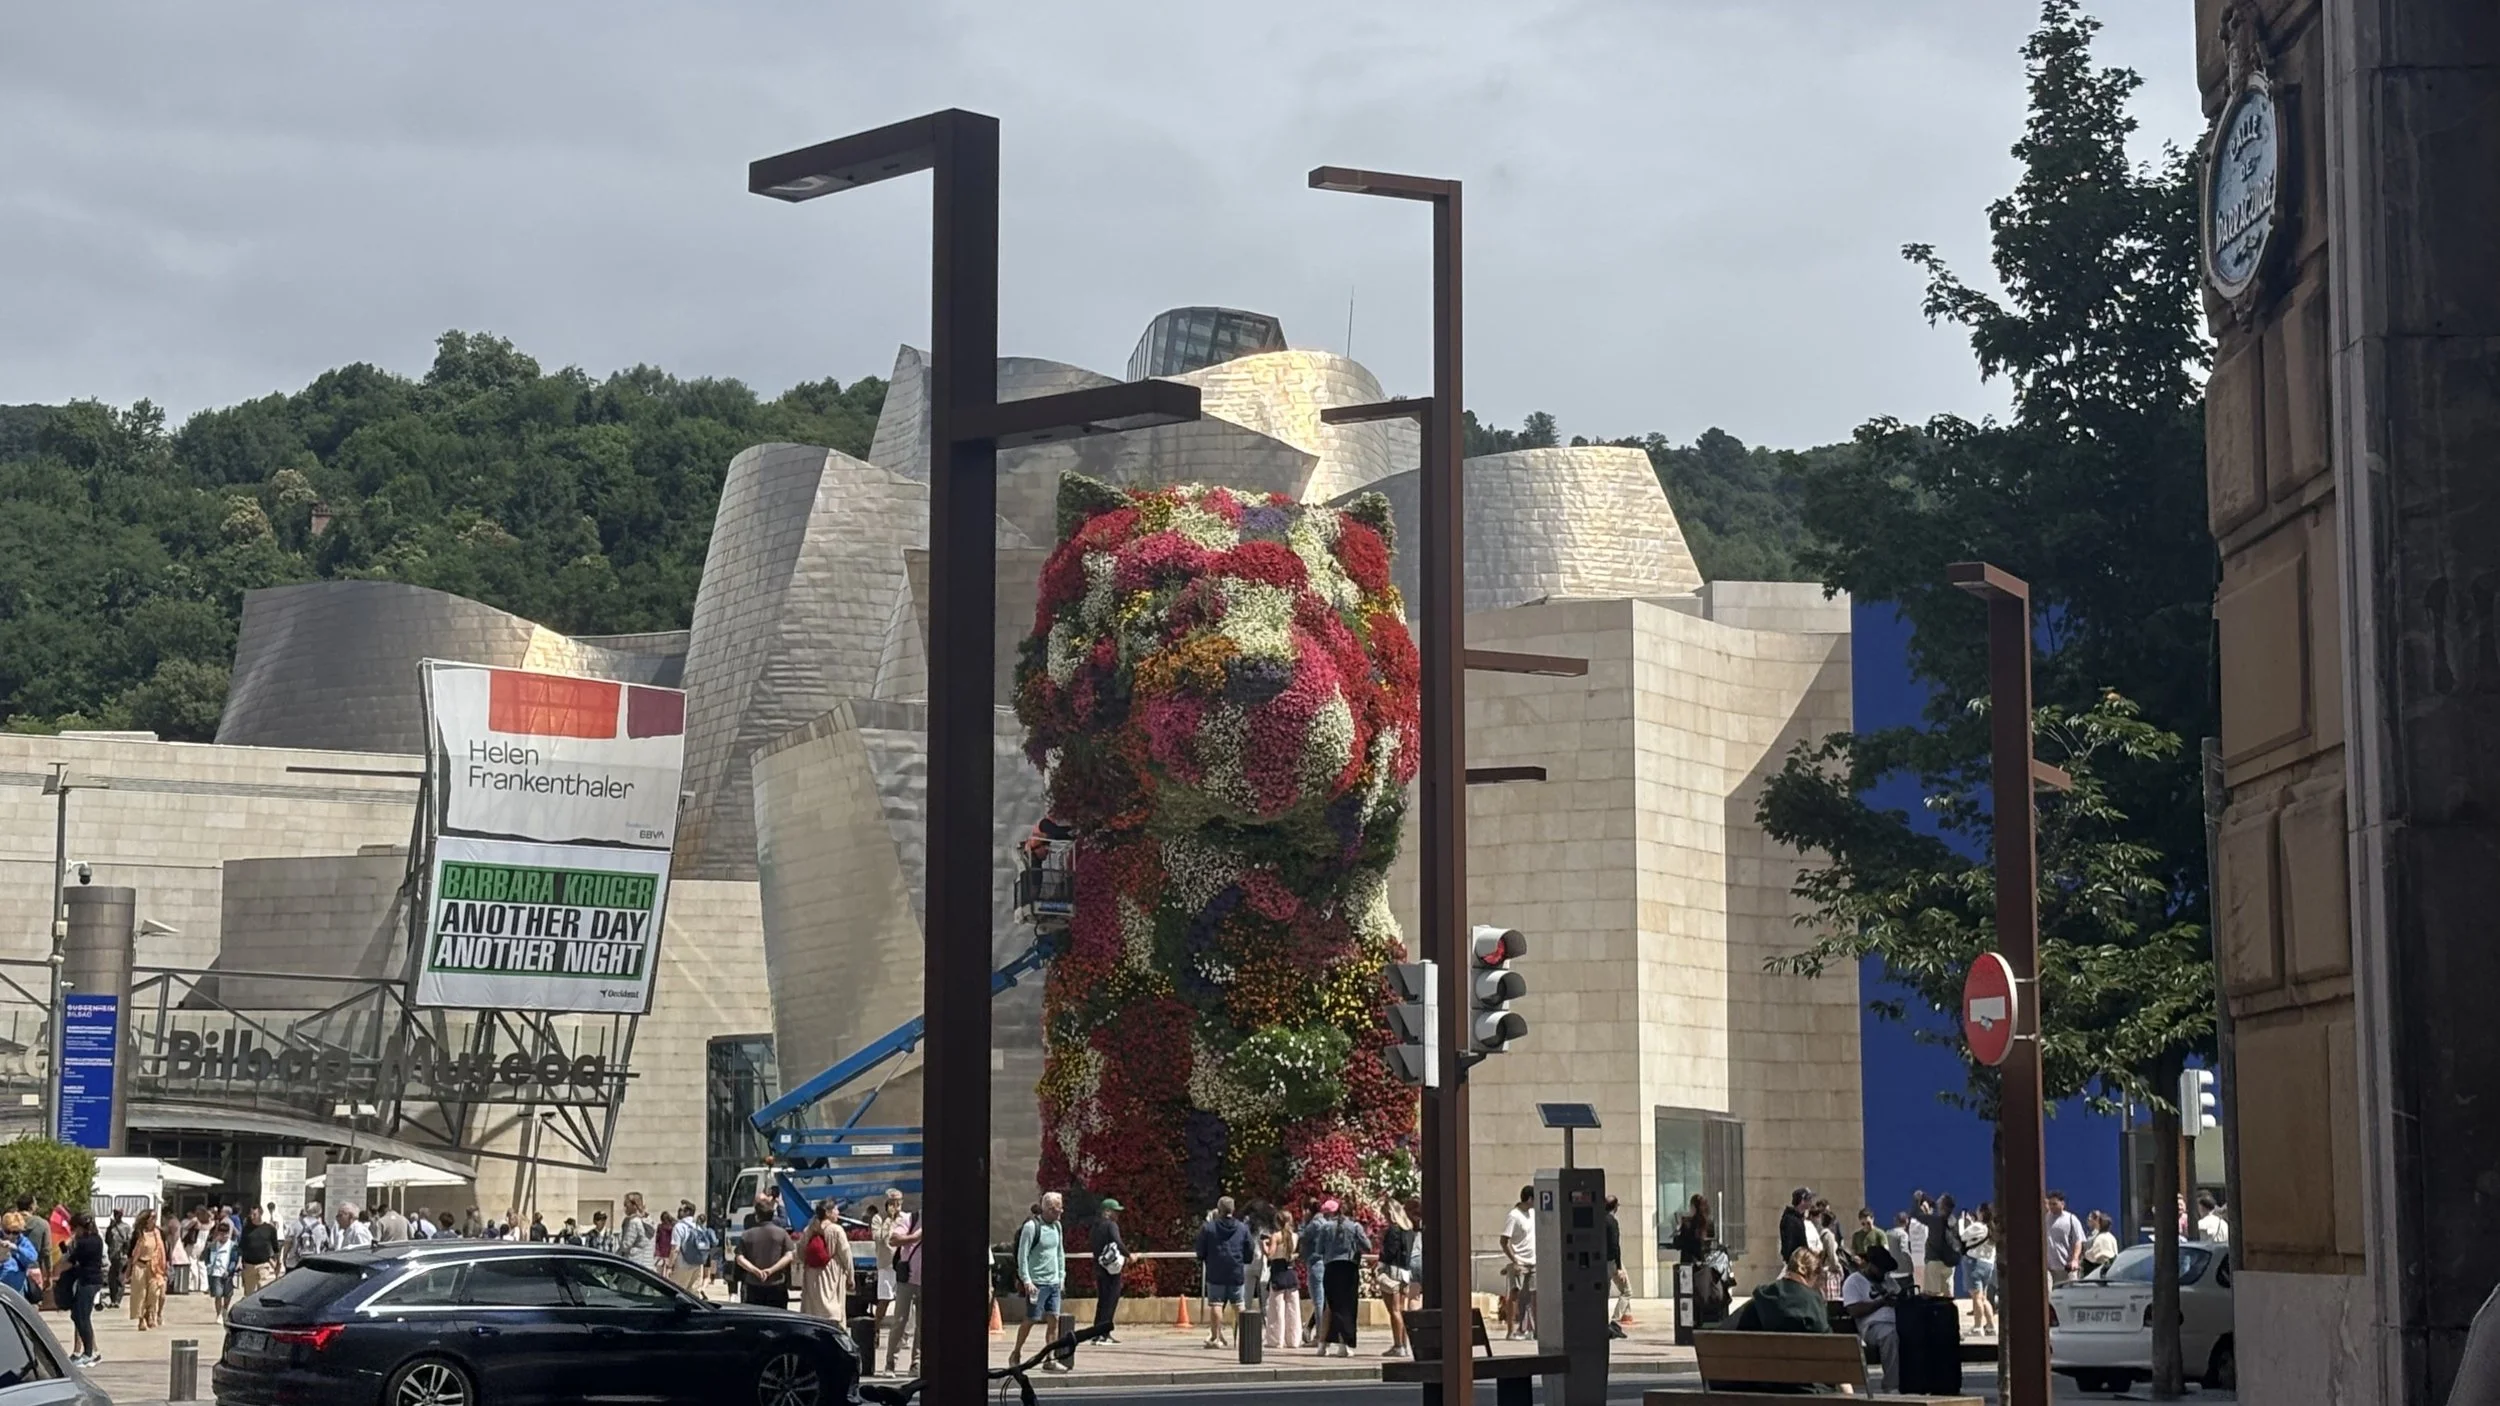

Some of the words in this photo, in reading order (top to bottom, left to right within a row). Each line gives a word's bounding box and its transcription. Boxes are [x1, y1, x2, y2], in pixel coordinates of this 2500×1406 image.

[2230, 115, 2259, 161] CALLE
[2239, 160, 2253, 181] DE
[469, 739, 539, 766] Helen
[469, 765, 635, 800] Frankenthaler
[640, 830, 665, 839] BBVA
[443, 866, 555, 904] BARBARA
[562, 873, 653, 910] KRUGER
[440, 902, 581, 939] ANOTHER
[590, 909, 648, 942] DAY
[434, 936, 556, 972] ANOTHER
[562, 941, 642, 975] NIGHT
[166, 1029, 350, 1083] Bilbao
[378, 1035, 606, 1088] Museoa
[1543, 1192, 1551, 1210] P
